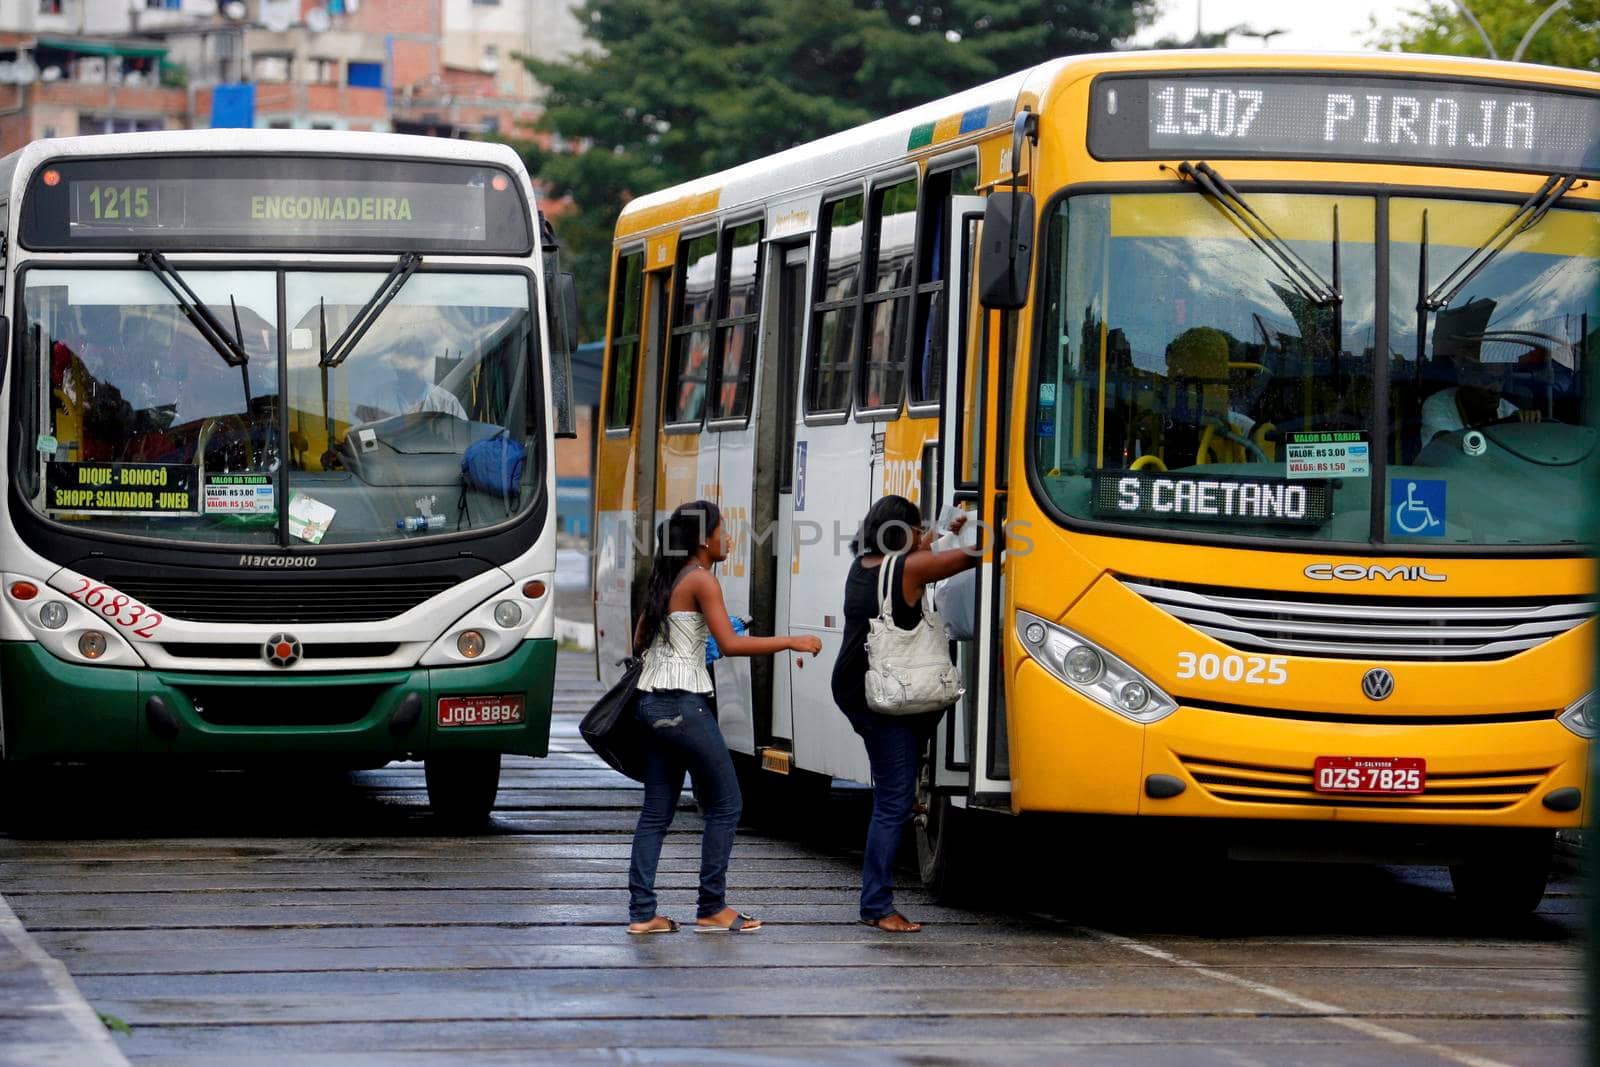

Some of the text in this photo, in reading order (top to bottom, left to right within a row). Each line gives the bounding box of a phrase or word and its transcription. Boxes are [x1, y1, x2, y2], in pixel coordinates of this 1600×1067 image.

[1156, 87, 1534, 149] 1507 PIRAJA
[90, 186, 412, 220] 1215 ENGOMADEIRA
[1294, 433, 1320, 443] VALOR
[1333, 432, 1361, 441] TARIFA
[79, 468, 112, 486] DIQUE
[121, 467, 167, 486] BONOCÔ
[211, 476, 232, 484] VALOR
[97, 490, 153, 508] SALVADOR
[1119, 477, 1306, 518] S CAETANO
[239, 555, 318, 568] Marcopolo
[1304, 563, 1447, 581] COMIL
[68, 578, 162, 638] 26832
[1176, 651, 1288, 685] 30025
